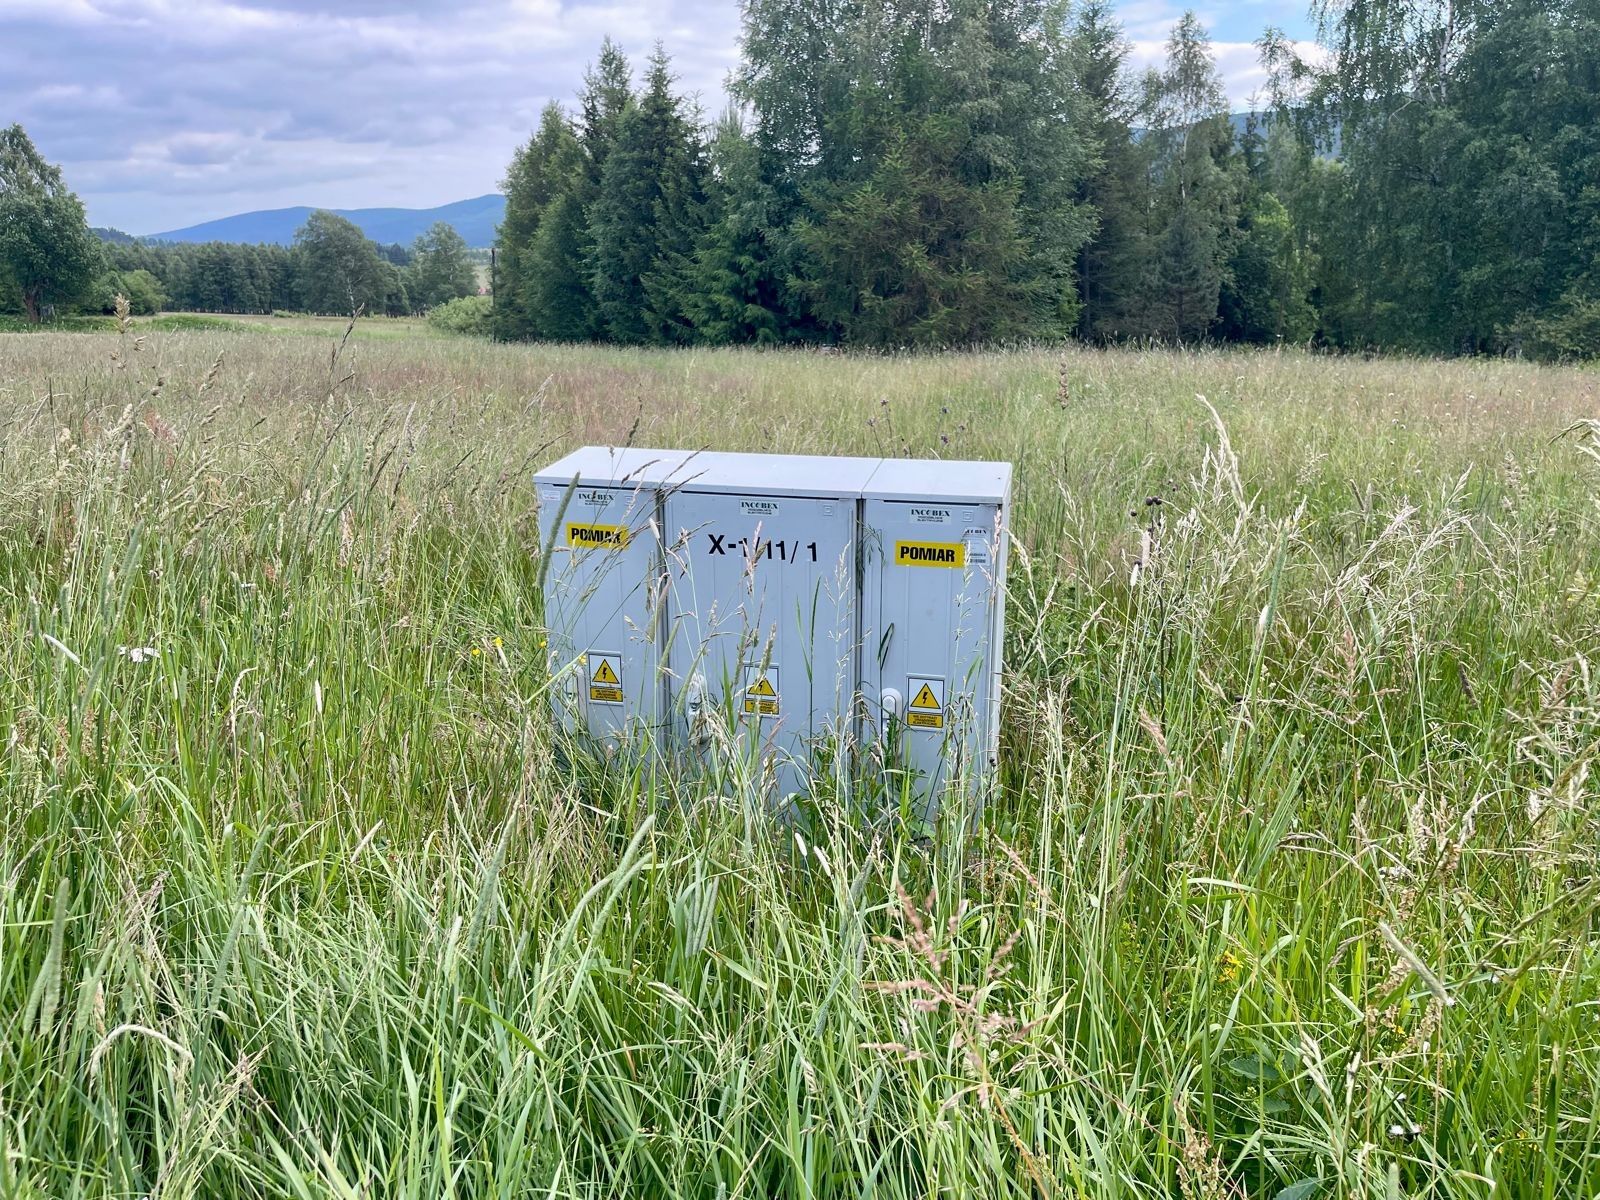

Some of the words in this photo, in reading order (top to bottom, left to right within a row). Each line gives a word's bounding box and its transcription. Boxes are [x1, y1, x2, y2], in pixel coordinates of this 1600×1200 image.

[578, 492, 615, 501] INCBEX
[741, 501, 778, 510] INCOBEX
[911, 508, 951, 517] INCOBEX
[900, 545, 955, 563] POMIAR
